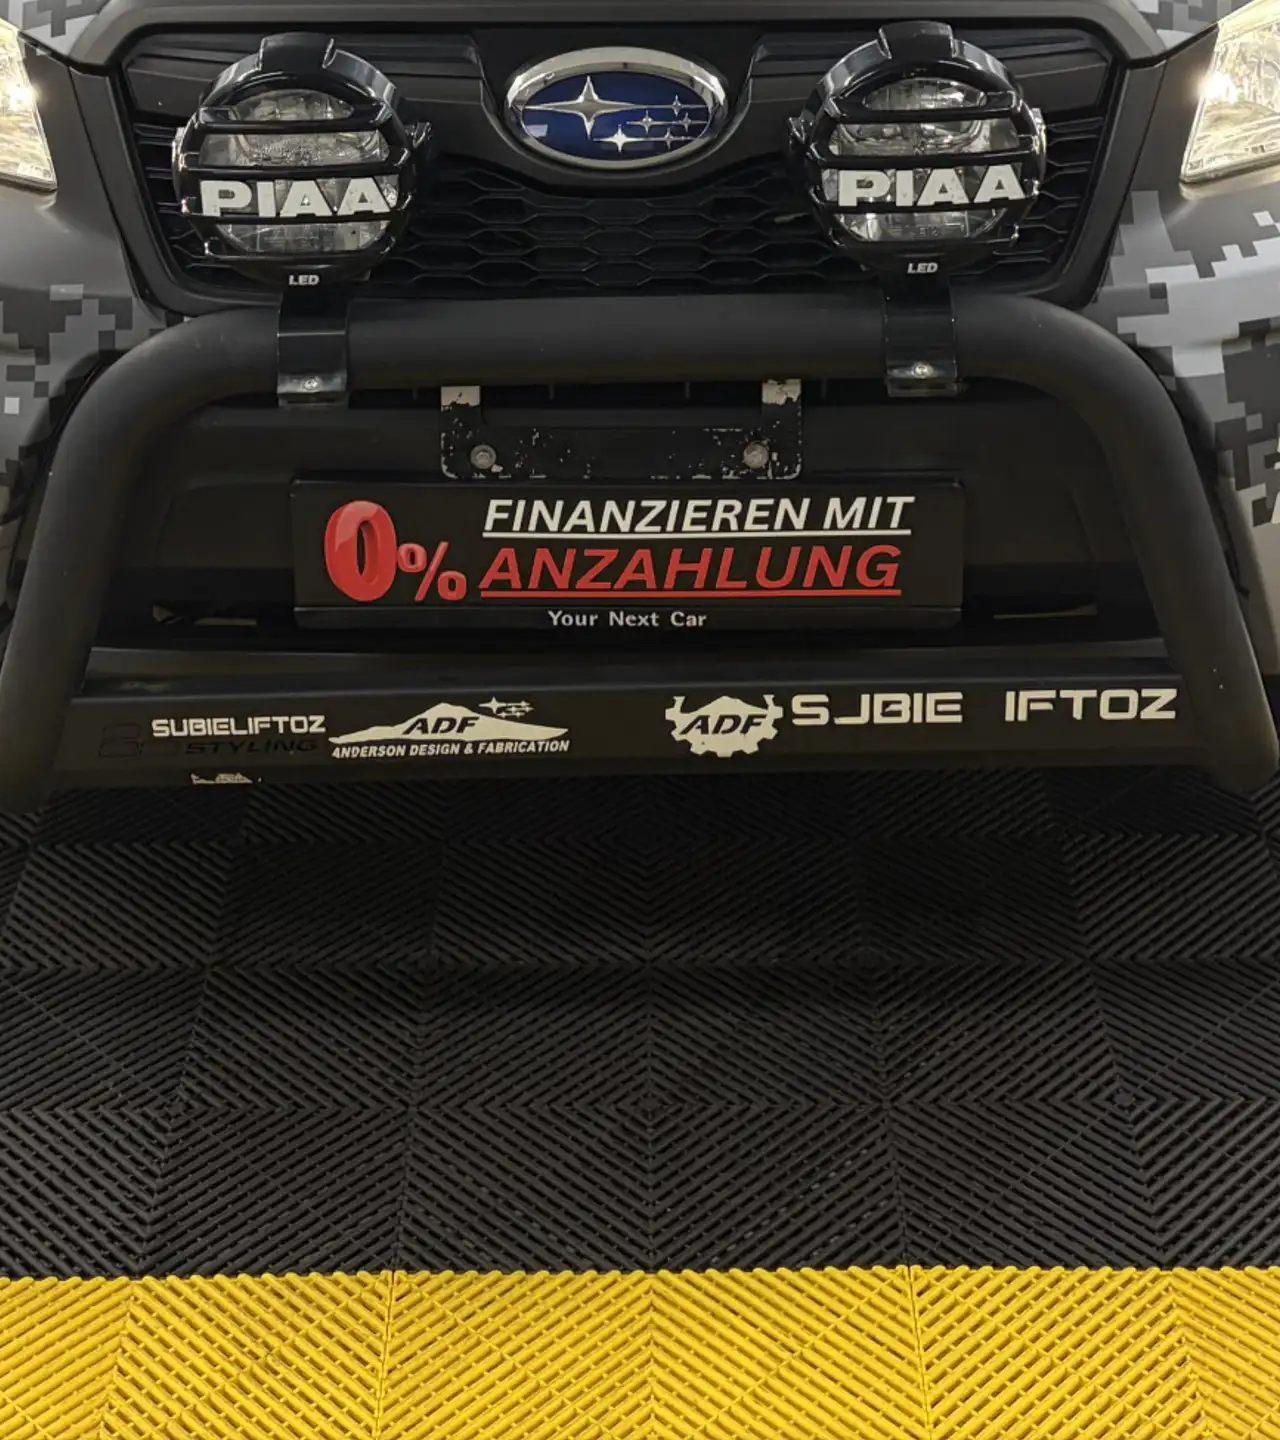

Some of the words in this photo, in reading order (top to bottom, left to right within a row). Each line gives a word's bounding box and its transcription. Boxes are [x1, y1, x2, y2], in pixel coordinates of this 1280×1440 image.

[837, 163, 1026, 207] PIAA
[200, 176, 391, 218] PIAA
[288, 274, 320, 286] LED
[906, 262, 939, 275] LED
[483, 497, 810, 533] FINANZIEREN
[822, 495, 916, 531] MIT
[324, 500, 467, 602] 0%
[479, 544, 902, 590] ANZAHLUNG
[547, 610, 599, 628] Your
[608, 610, 659, 628] Next
[669, 610, 707, 628] Car
[151, 714, 326, 738] SUBIELIFTOZ
[402, 716, 480, 735] ADF
[679, 713, 767, 736] ADF
[184, 738, 320, 755] STYLING
[332, 744, 407, 759] ANDERSON
[409, 743, 460, 756] DESIGN
[463, 743, 474, 755] &
[477, 739, 570, 755] FABRICATION
